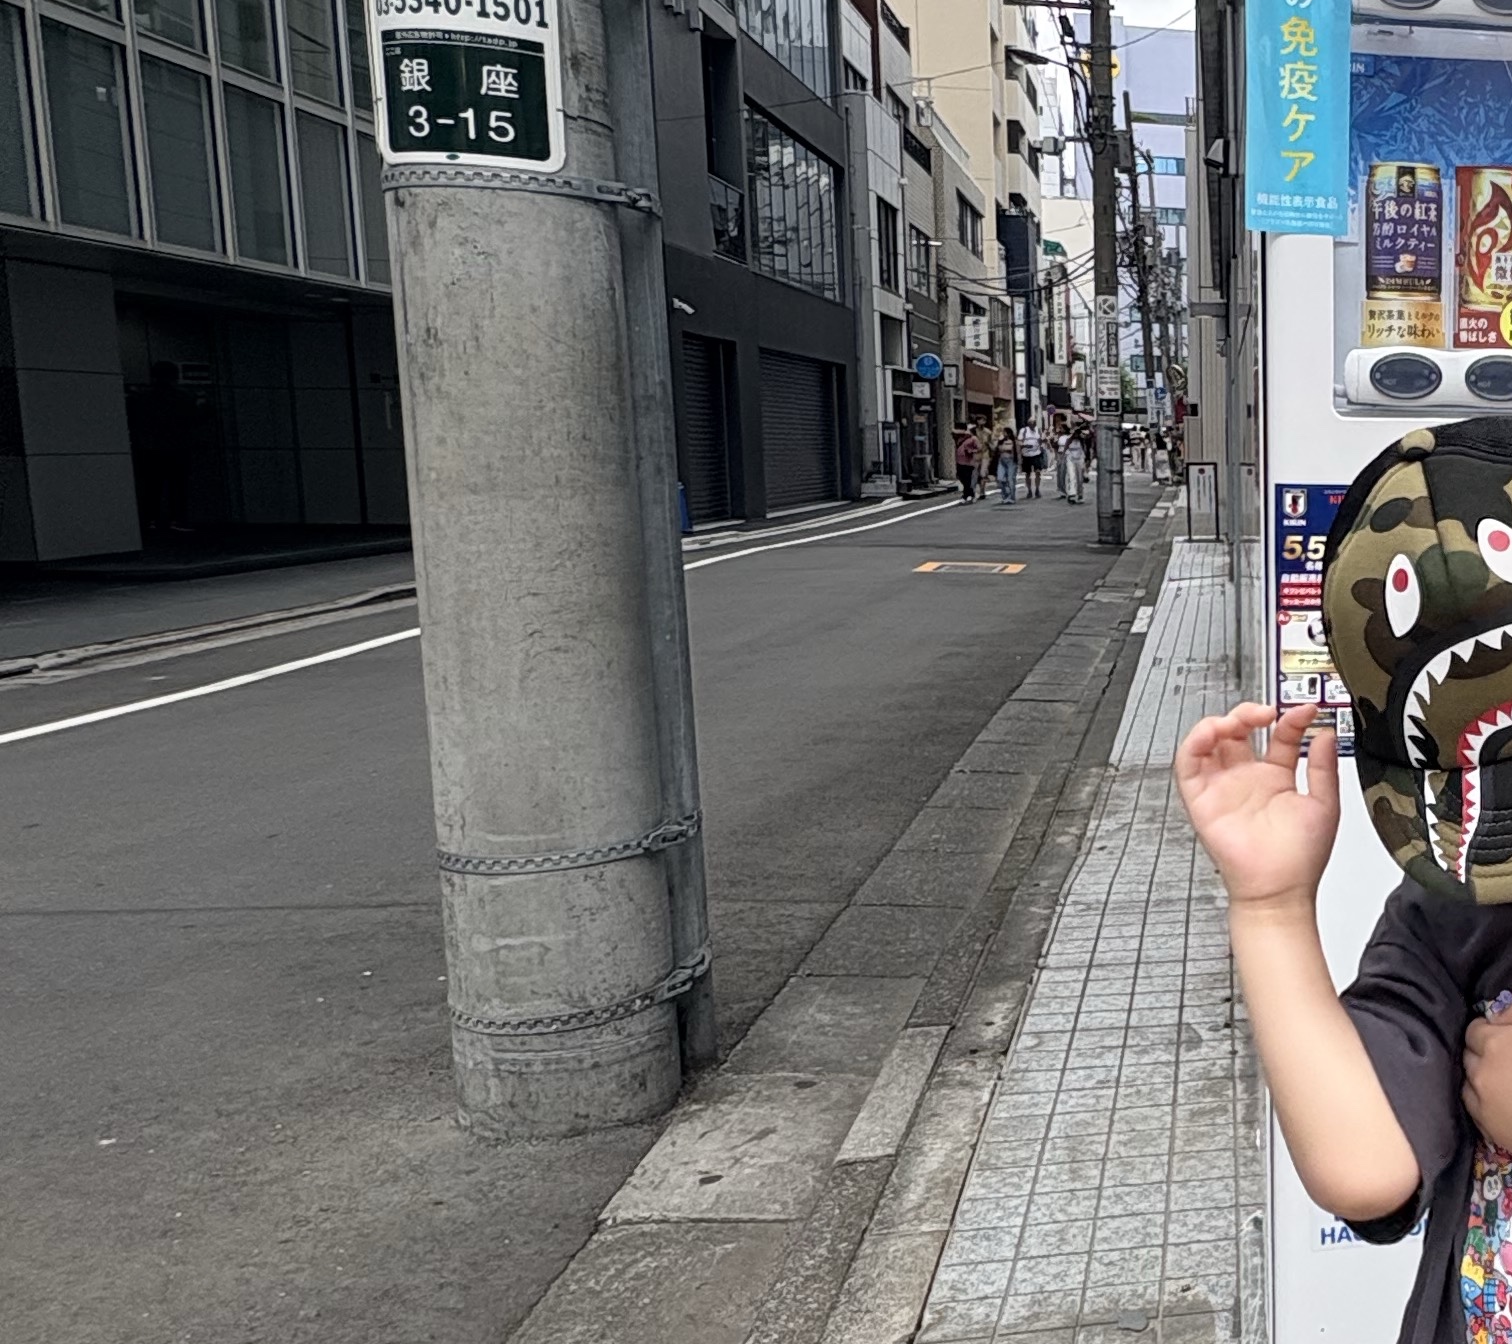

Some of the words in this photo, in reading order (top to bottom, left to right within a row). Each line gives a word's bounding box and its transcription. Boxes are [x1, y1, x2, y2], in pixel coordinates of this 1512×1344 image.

[408, 106, 517, 143] 3-15
[1372, 200, 1438, 222] 午後の紅茶
[1375, 238, 1436, 252] ミルクティー
[1459, 317, 1489, 330] 直火の
[1367, 324, 1441, 340] リッチな味わい
[1459, 329, 1498, 344] 香ばしさ
[1282, 518, 1307, 527] KIRIN
